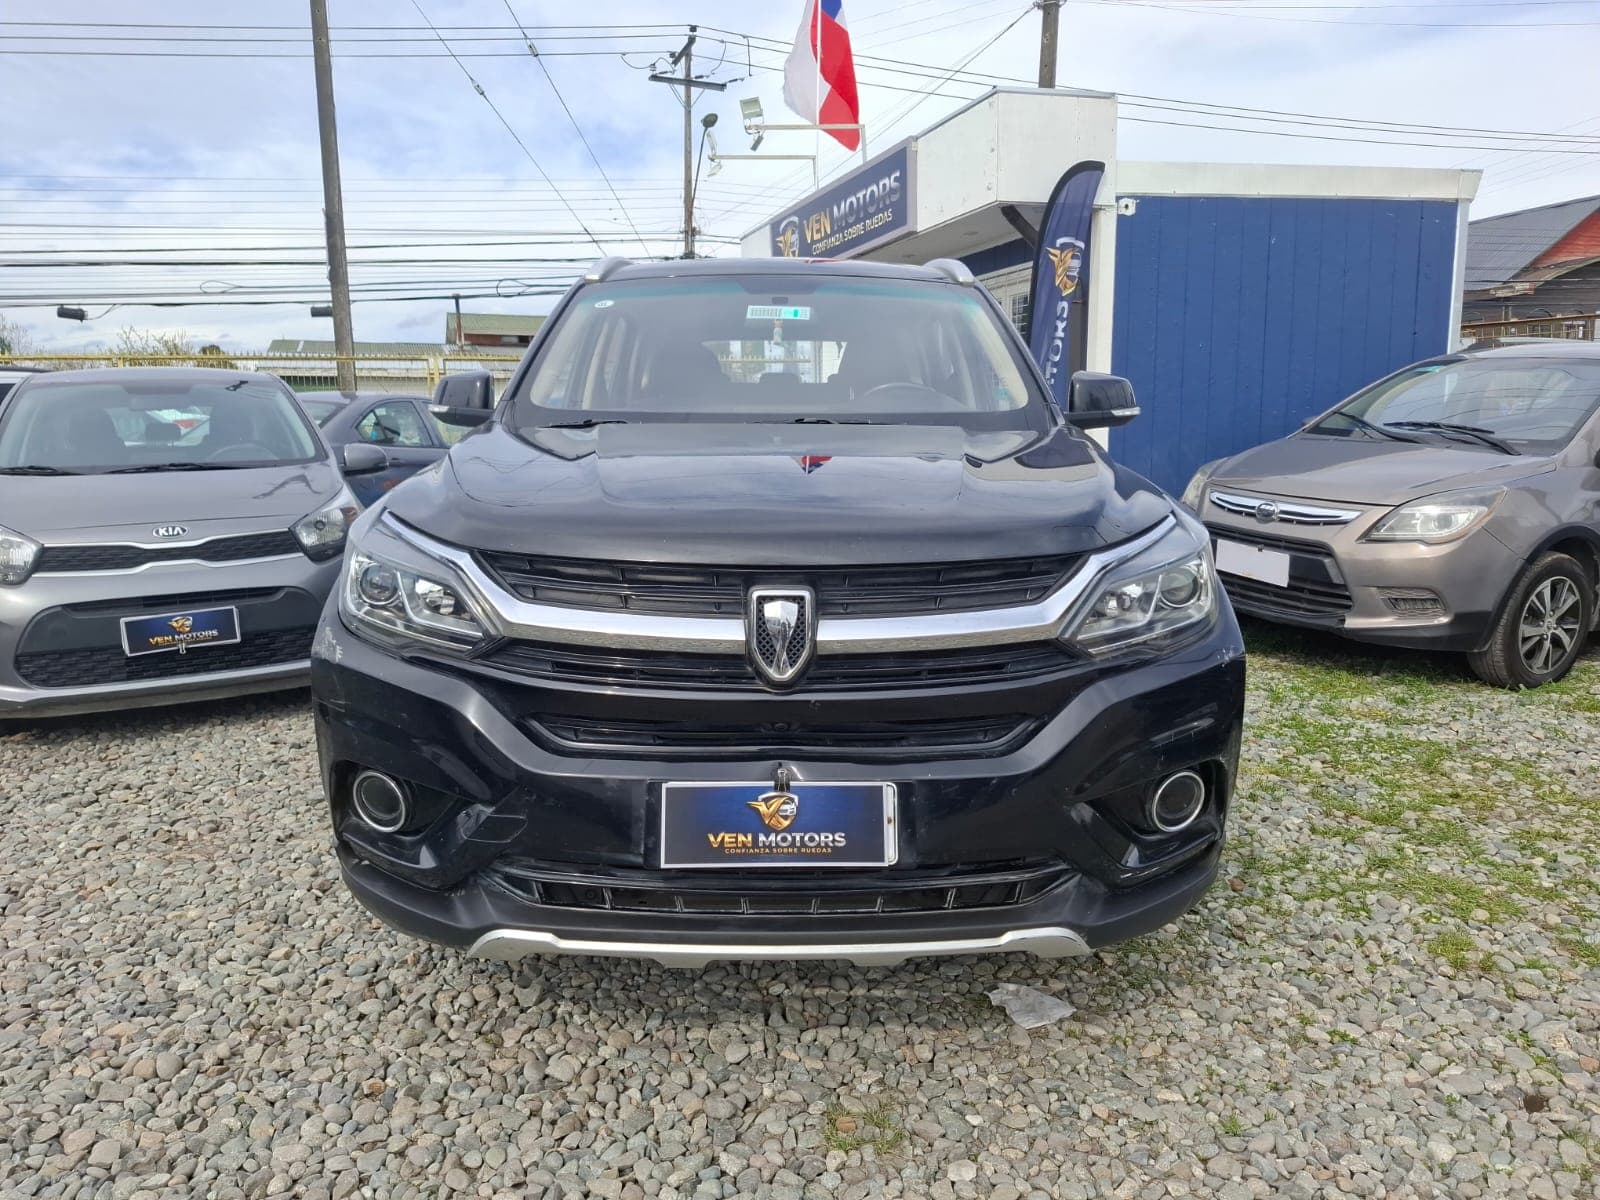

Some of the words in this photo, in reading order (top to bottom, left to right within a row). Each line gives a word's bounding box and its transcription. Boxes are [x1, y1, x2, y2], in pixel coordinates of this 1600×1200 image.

[803, 207, 831, 243] VEN
[833, 170, 901, 230] MOTORS
[812, 237, 843, 255] CONFIANZA
[844, 224, 865, 240] SOBRE
[865, 208, 893, 231] RUEDAS
[1046, 301, 1069, 385] TORS
[159, 527, 183, 536] KIA
[149, 635, 173, 645] VEN
[174, 629, 219, 641] MOTORS
[707, 832, 752, 848] VEN
[758, 832, 847, 847] MOTORS
